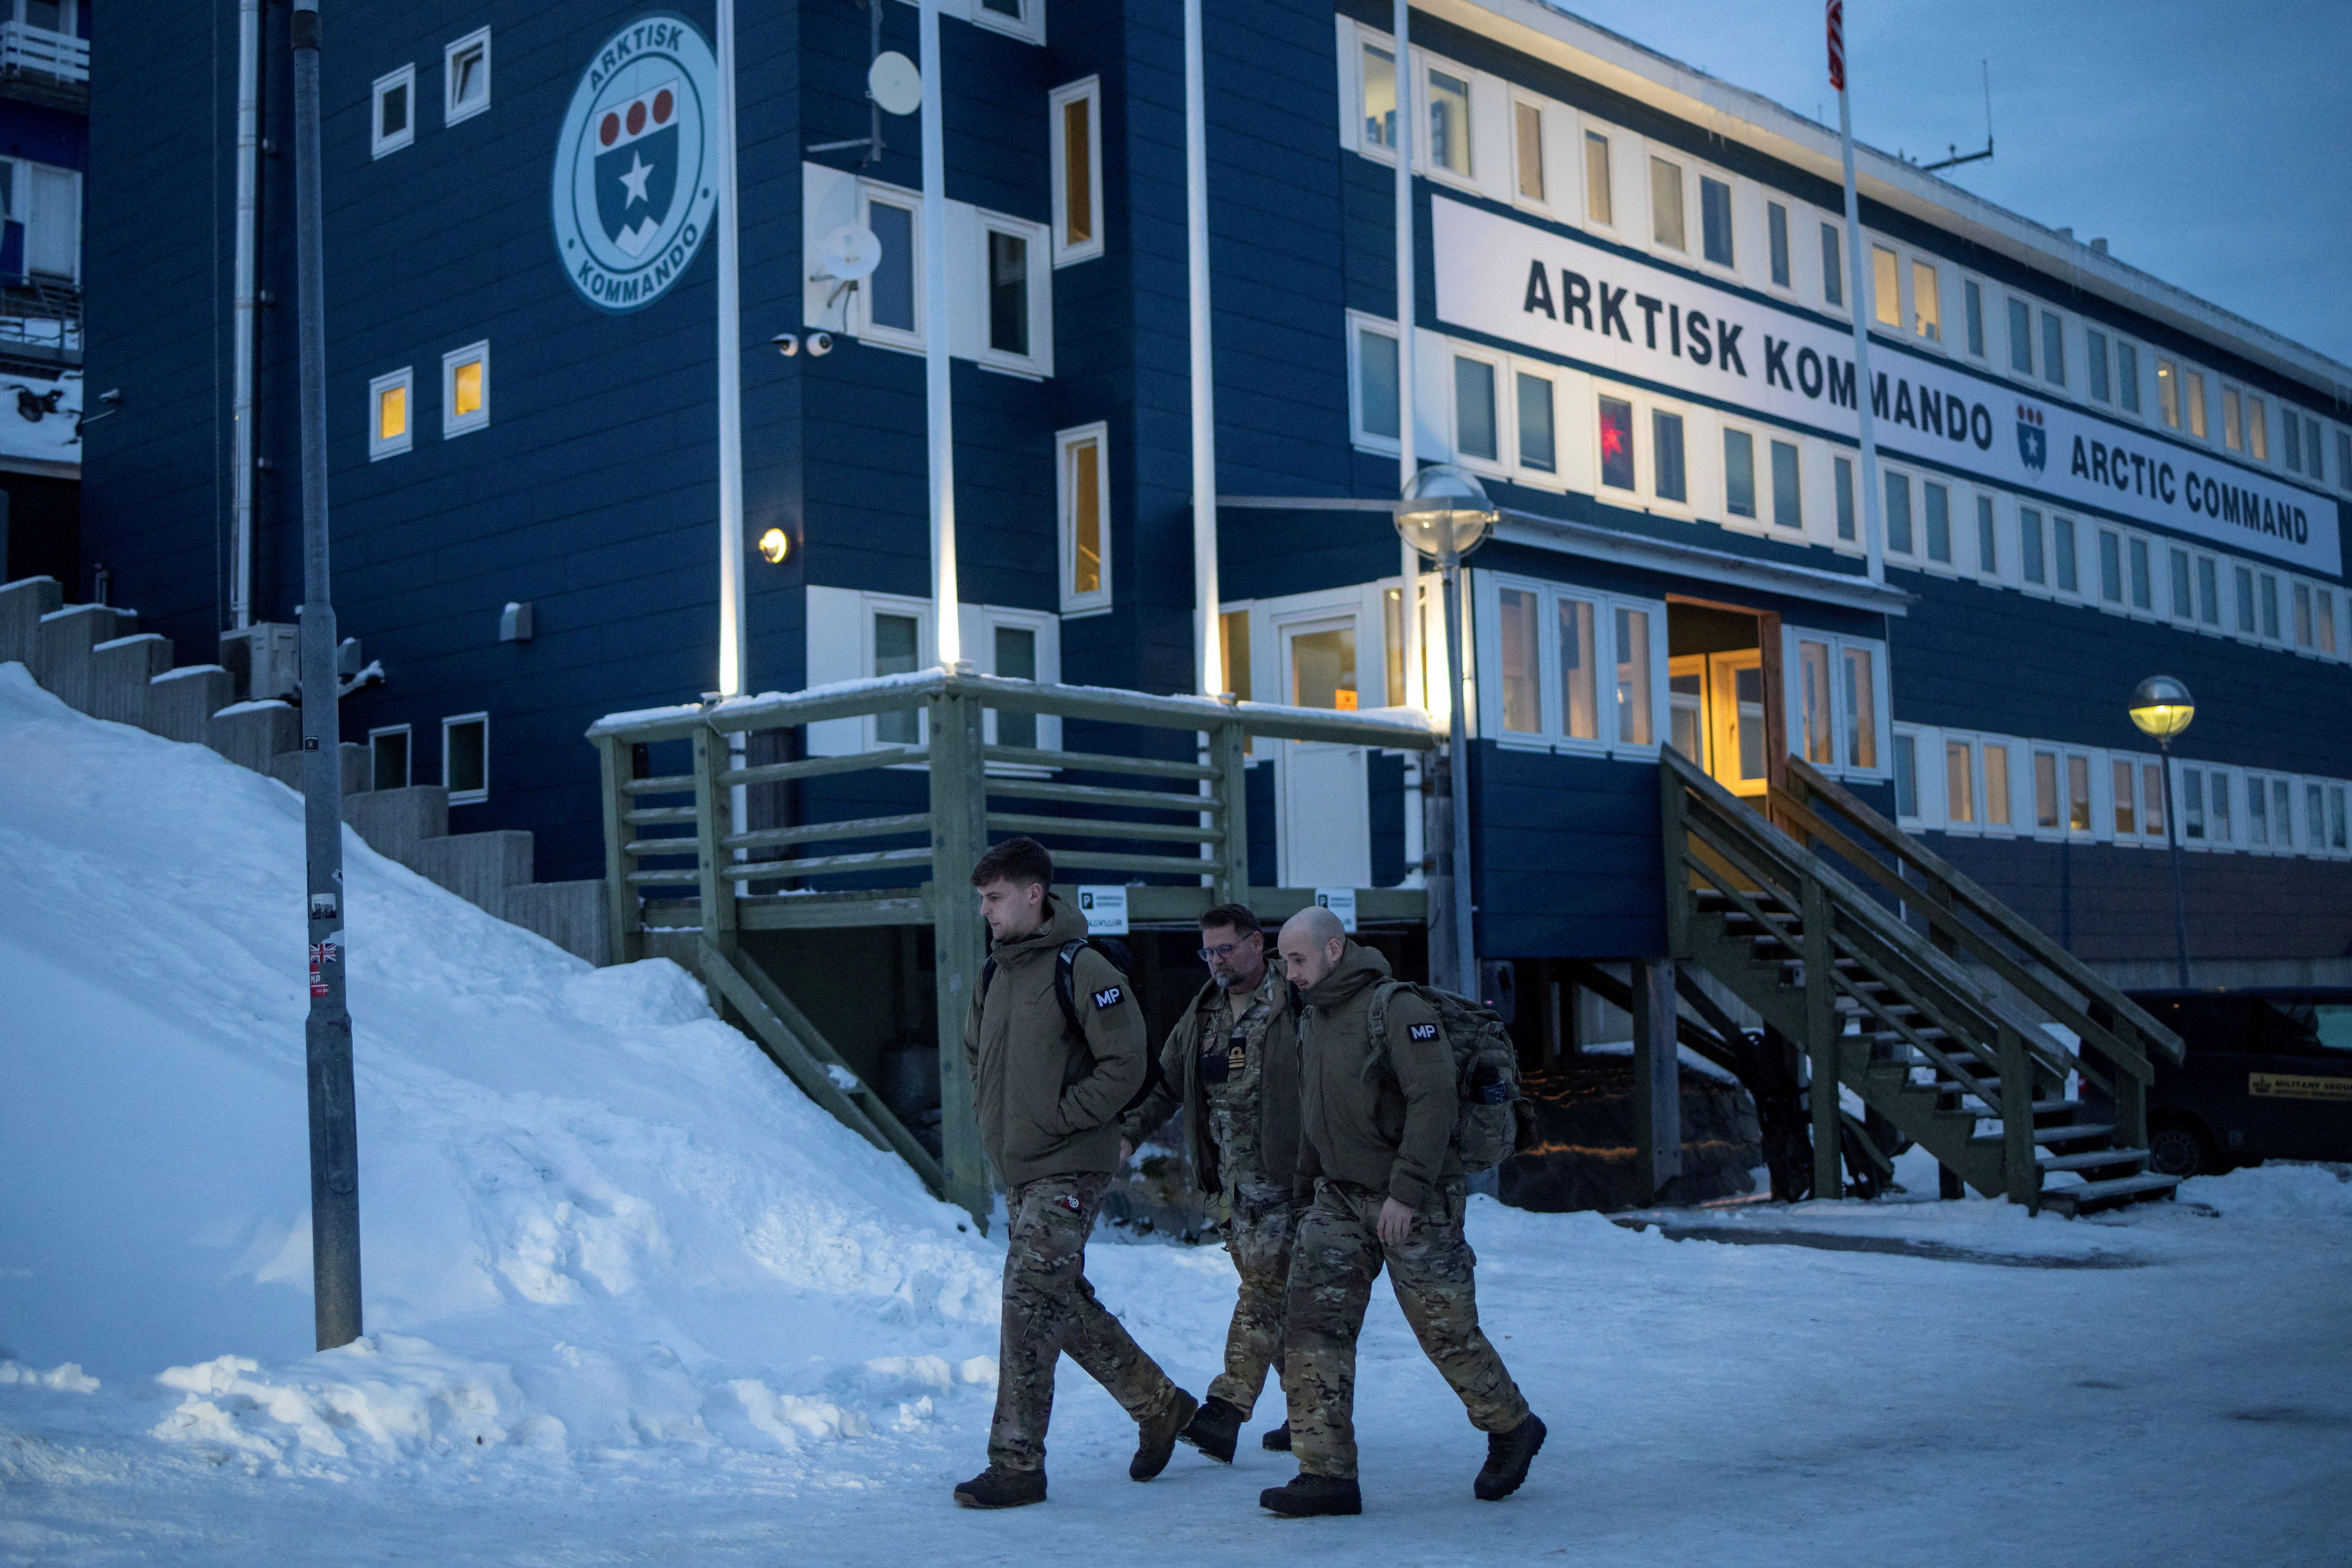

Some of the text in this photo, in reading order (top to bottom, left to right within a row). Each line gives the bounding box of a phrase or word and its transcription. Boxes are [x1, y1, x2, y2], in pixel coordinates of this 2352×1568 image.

[590, 22, 685, 92] ARKTISK
[577, 222, 698, 303] KOMMANDO
[1523, 259, 1992, 451] ARKTISK KOMMANDO
[2071, 435, 2308, 544] ARCTIC COMMAND
[1096, 988, 1120, 1007] MP
[1411, 1025, 1435, 1039] MP
